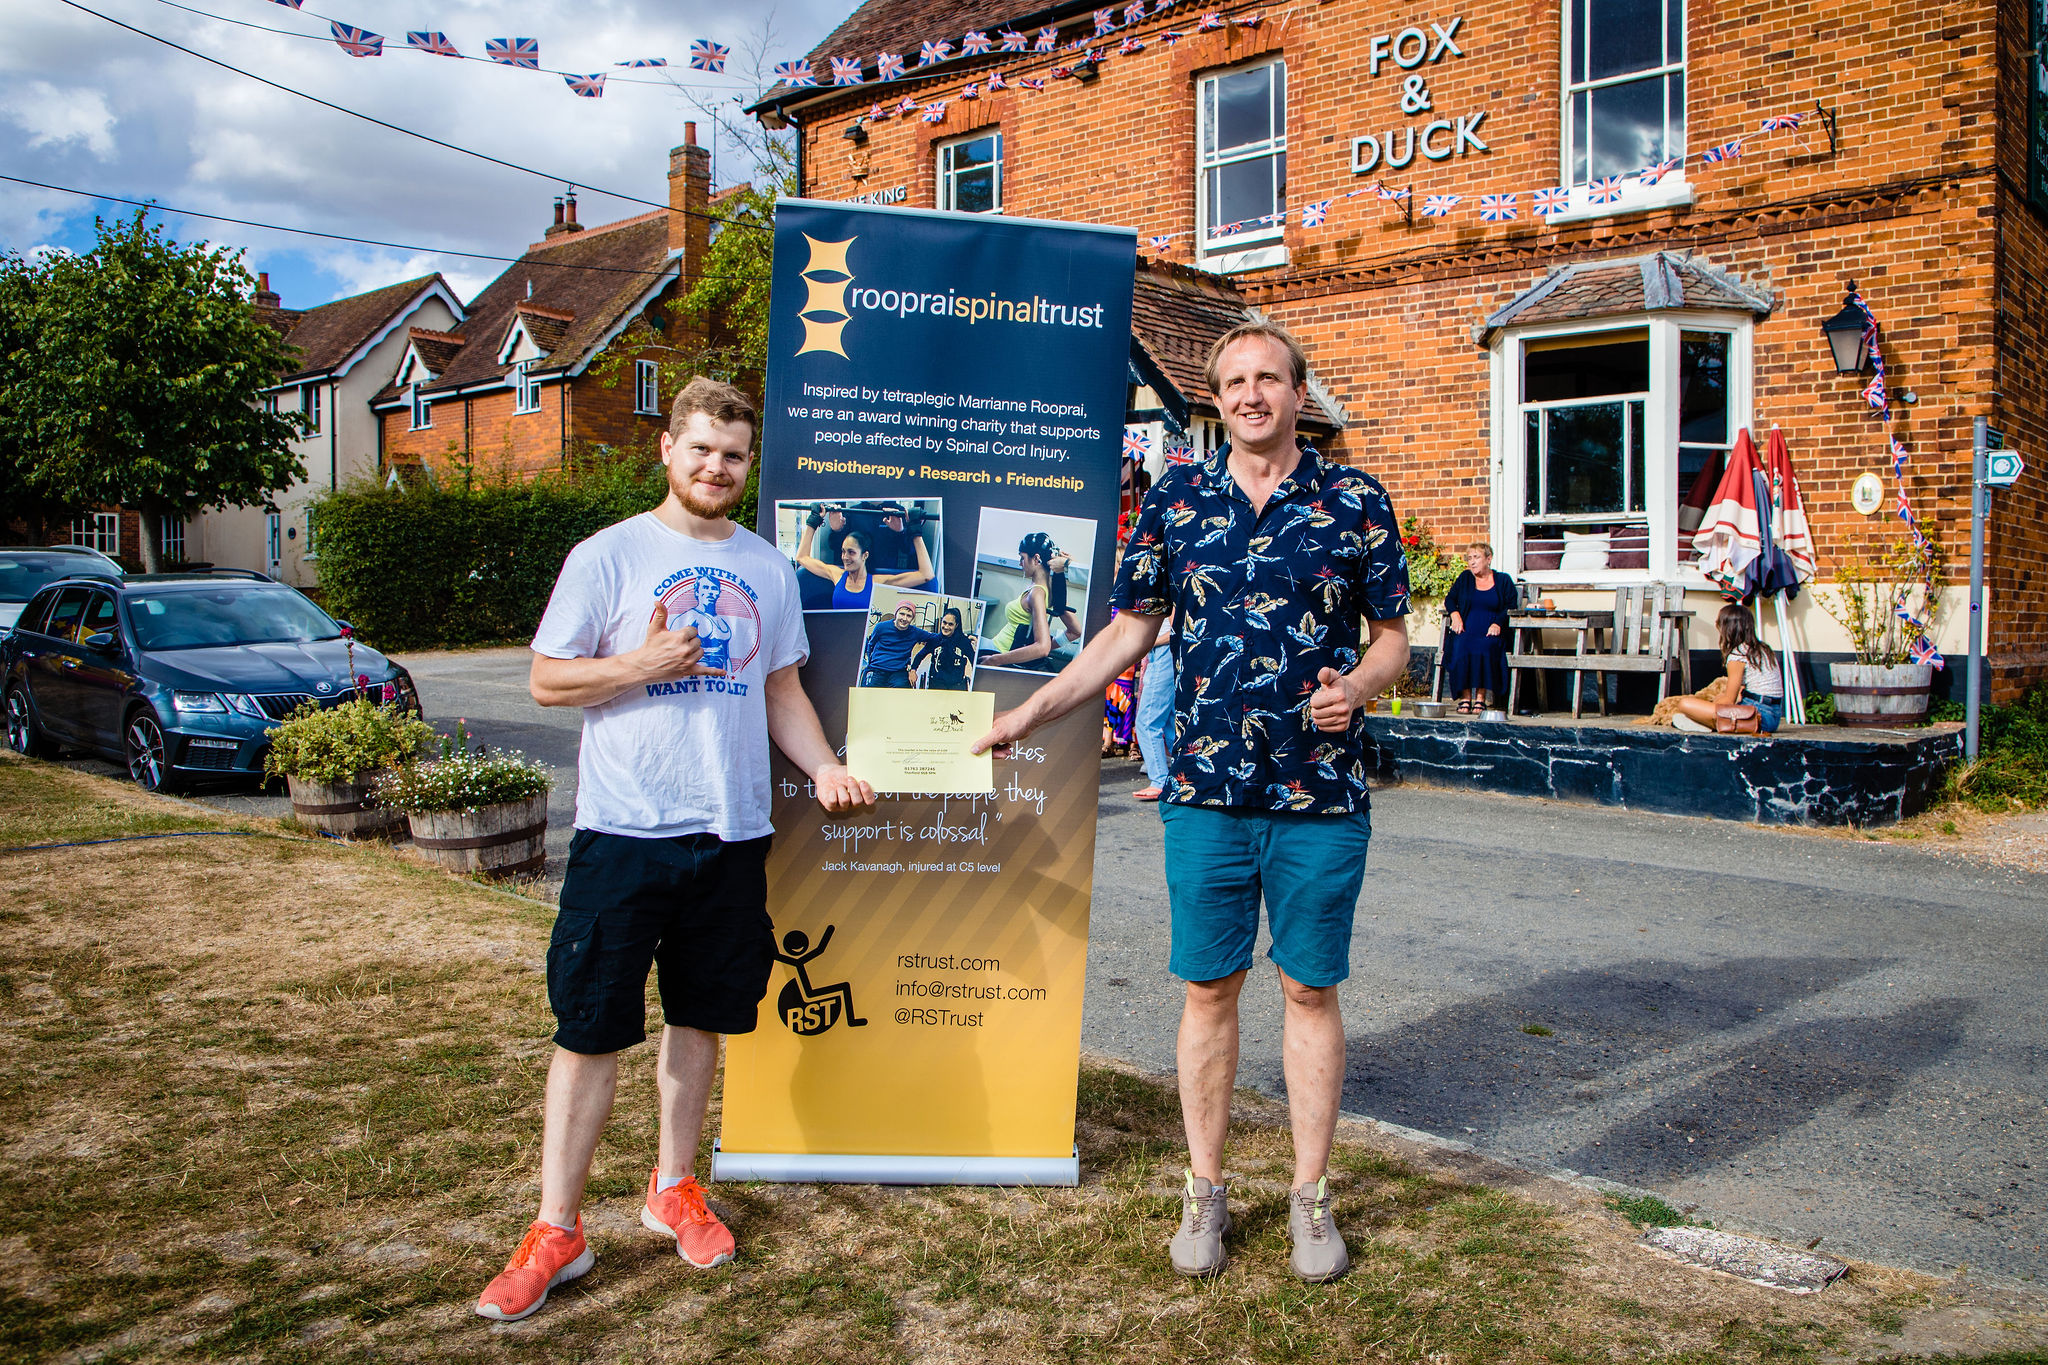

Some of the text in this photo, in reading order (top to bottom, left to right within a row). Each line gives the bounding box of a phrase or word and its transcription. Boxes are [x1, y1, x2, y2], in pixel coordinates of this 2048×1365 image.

[1369, 16, 1463, 75] FOX
[1400, 75, 1431, 114] &
[1351, 111, 1488, 174] DUCK
[871, 186, 907, 205] KING
[850, 288, 1104, 328] roopraispinaltrust
[803, 382, 1087, 418] Inspired by tetraplegic Marrianne Rooprai,
[788, 407, 1100, 440] we are an award winning charity that supports
[815, 431, 1069, 462] people affected by Spinal Cord Injury.
[798, 457, 1084, 492] Physiotherapy Research Friendship
[653, 566, 759, 602] COME WITH ME
[646, 680, 700, 697] WANT
[705, 680, 726, 693] TO
[1005, 740, 1048, 763] akes
[779, 777, 798, 798] to
[1004, 771, 1048, 815] they
[821, 821, 896, 853] support
[900, 821, 915, 842] is
[822, 861, 1001, 874] Jack Kavanagh, injured at C5 level
[897, 953, 1000, 972] rstrust.com
[896, 980, 1047, 1001] info@rstrust.com
[787, 999, 837, 1032] RST
[894, 1008, 984, 1027] @RSTrust
